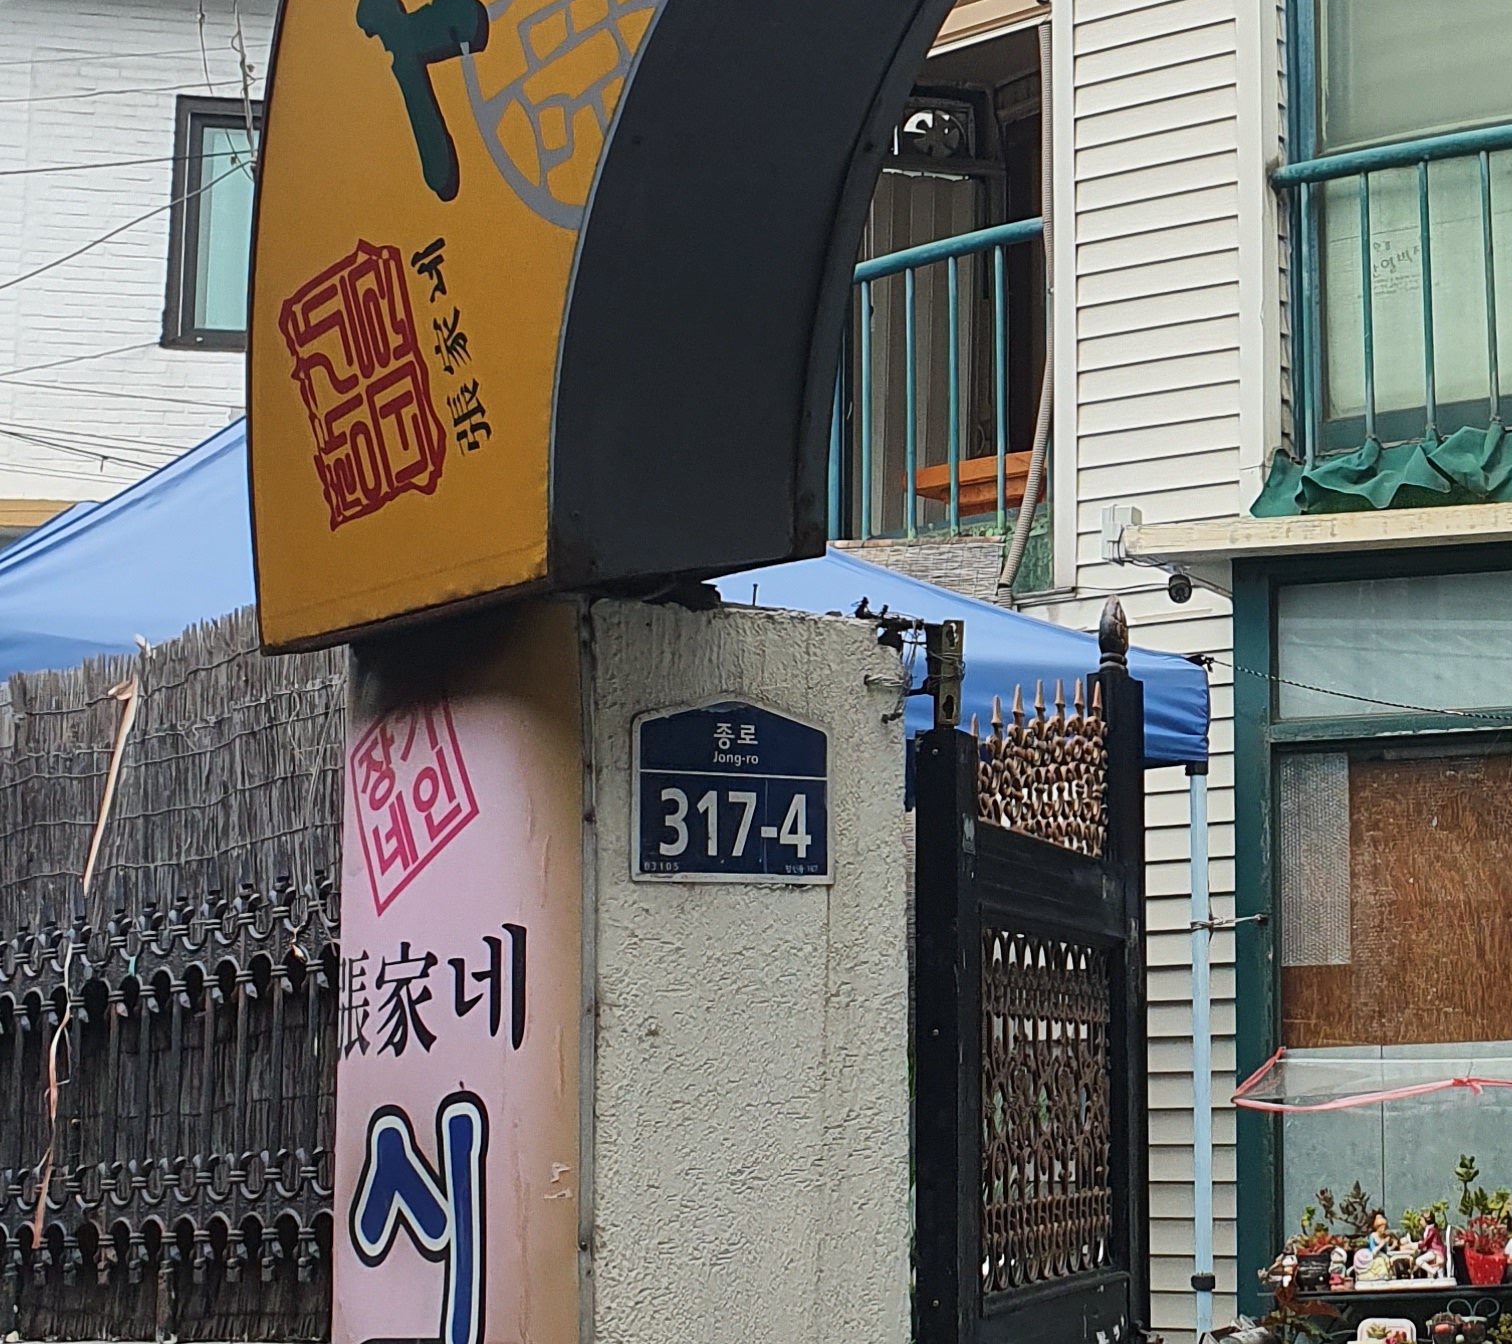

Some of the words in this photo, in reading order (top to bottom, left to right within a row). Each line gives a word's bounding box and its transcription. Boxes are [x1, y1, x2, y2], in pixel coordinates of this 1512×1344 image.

[713, 722, 759, 750] 종로
[713, 751, 759, 767] Jong-ro
[659, 787, 812, 858] 317-4
